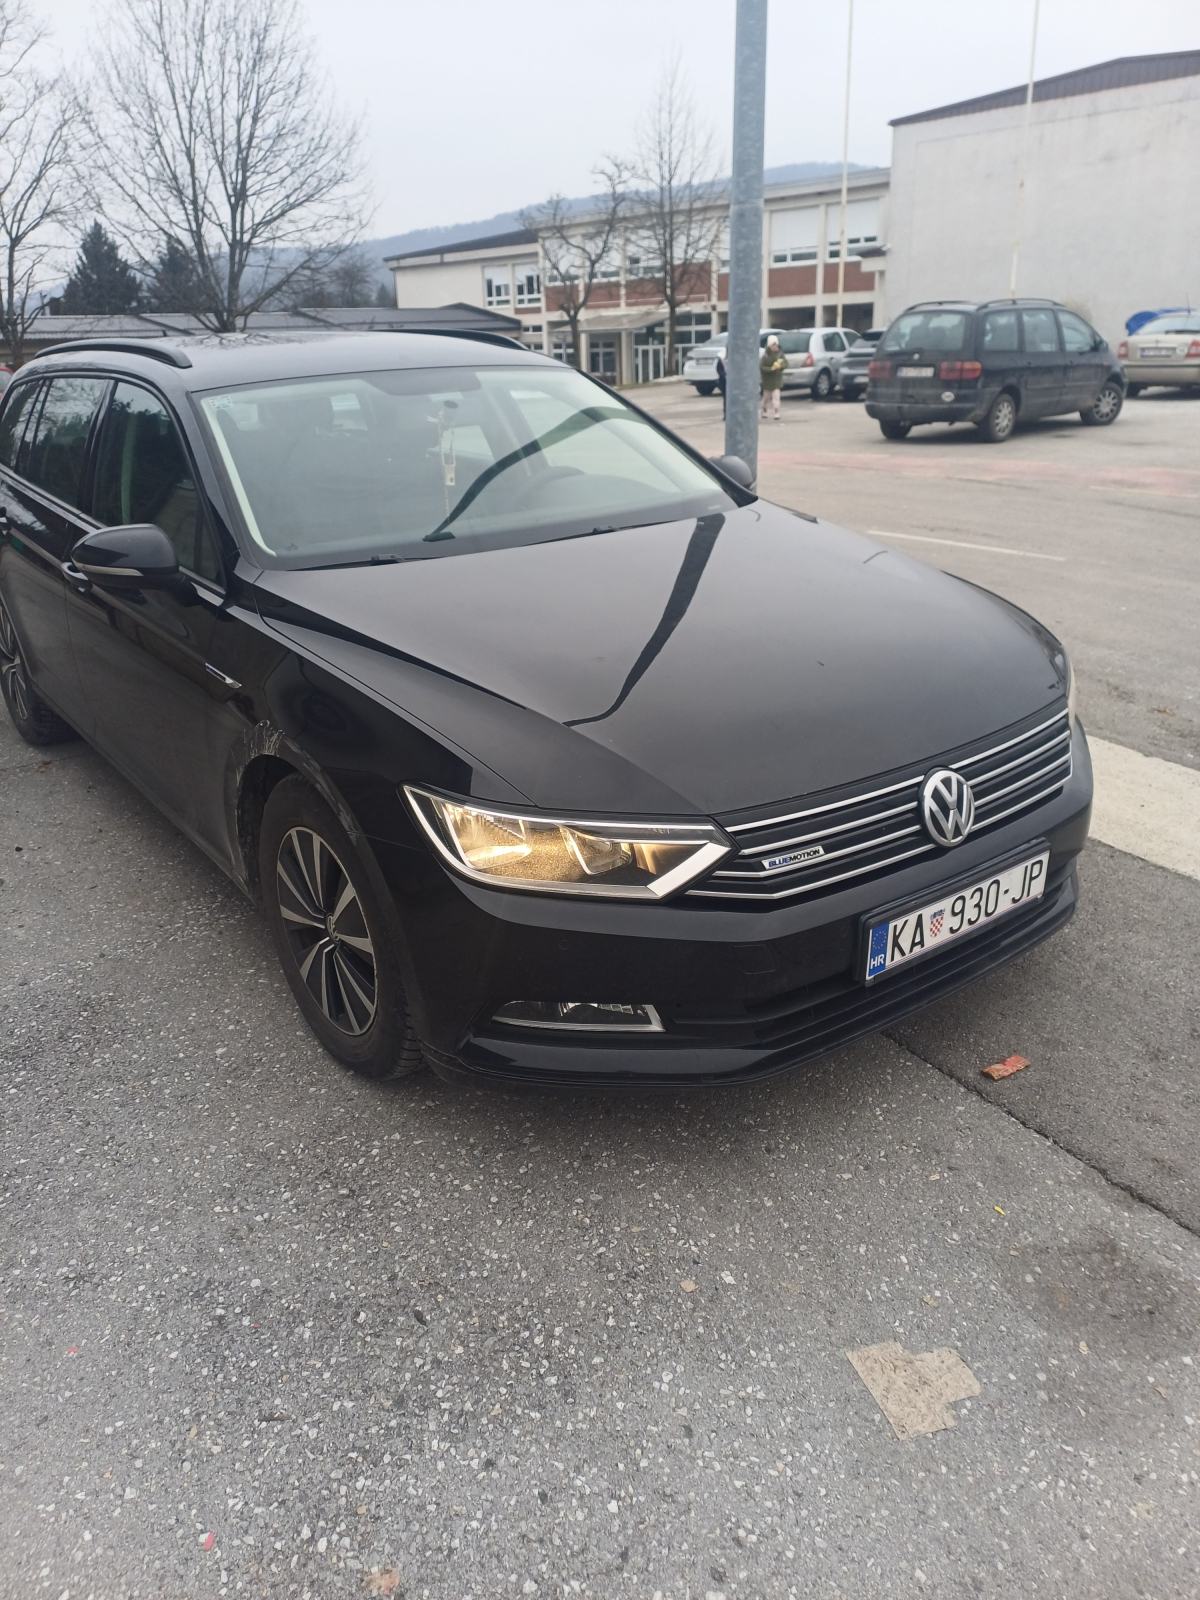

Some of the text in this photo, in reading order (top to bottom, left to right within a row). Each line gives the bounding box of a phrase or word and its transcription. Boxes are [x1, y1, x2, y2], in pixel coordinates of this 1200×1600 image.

[768, 847, 820, 868] BLUEMOTION
[890, 859, 1044, 962] KA 930-JP
[870, 953, 885, 969] HR
